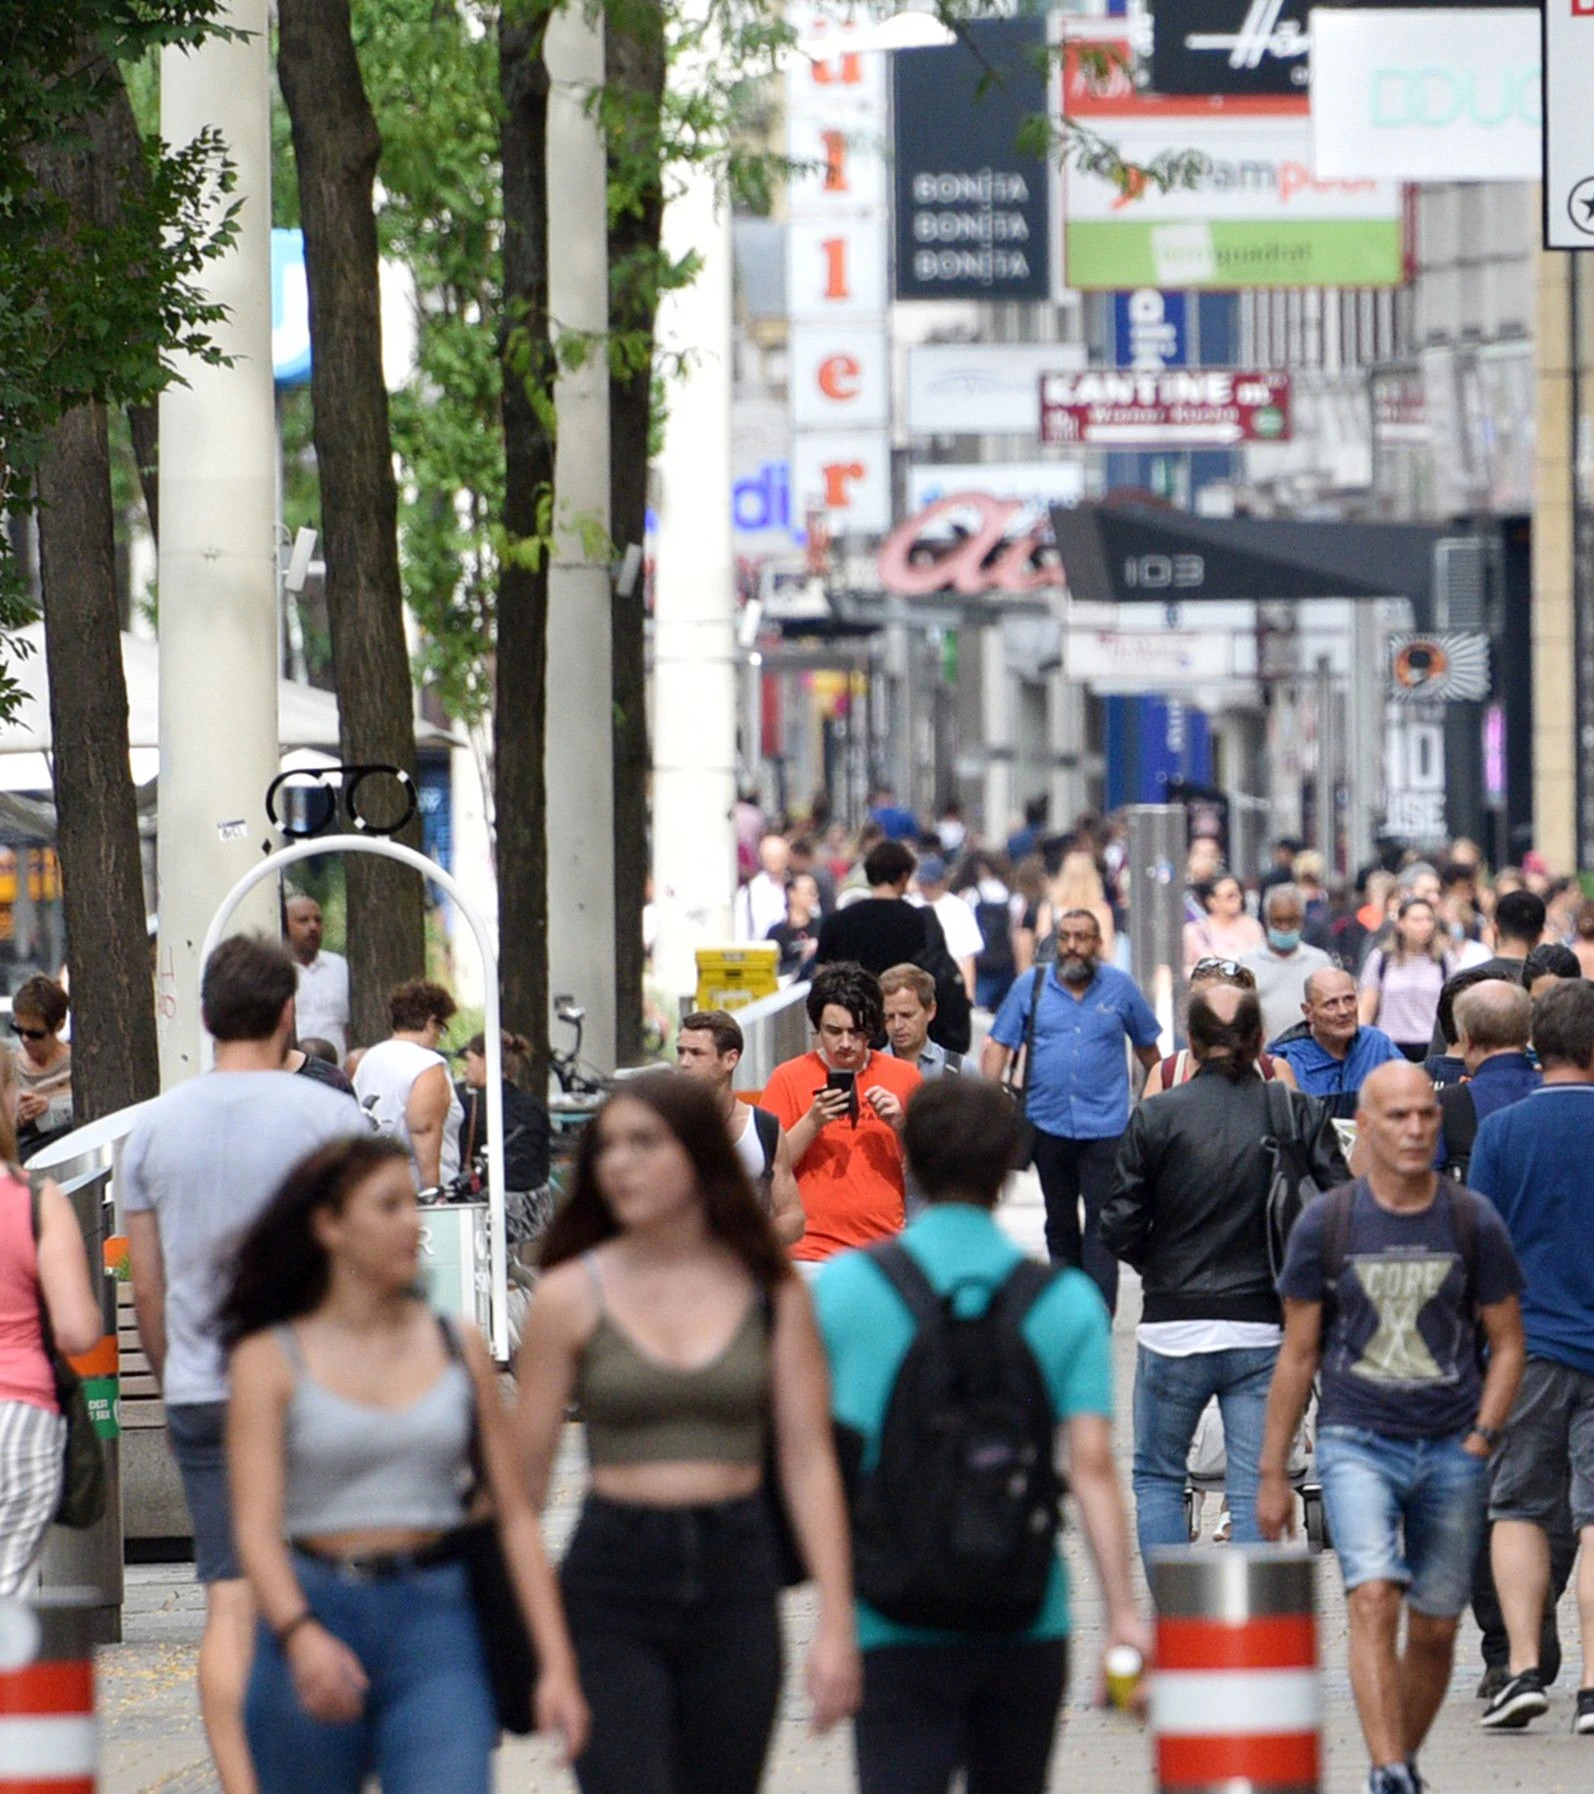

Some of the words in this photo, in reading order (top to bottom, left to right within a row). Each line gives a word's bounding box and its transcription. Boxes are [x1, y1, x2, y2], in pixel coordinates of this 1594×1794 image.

[912, 175, 1029, 204] BONITA
[913, 212, 1029, 243] BONITA
[913, 249, 1031, 282] BONITA
[1044, 372, 1233, 406] KANTINE
